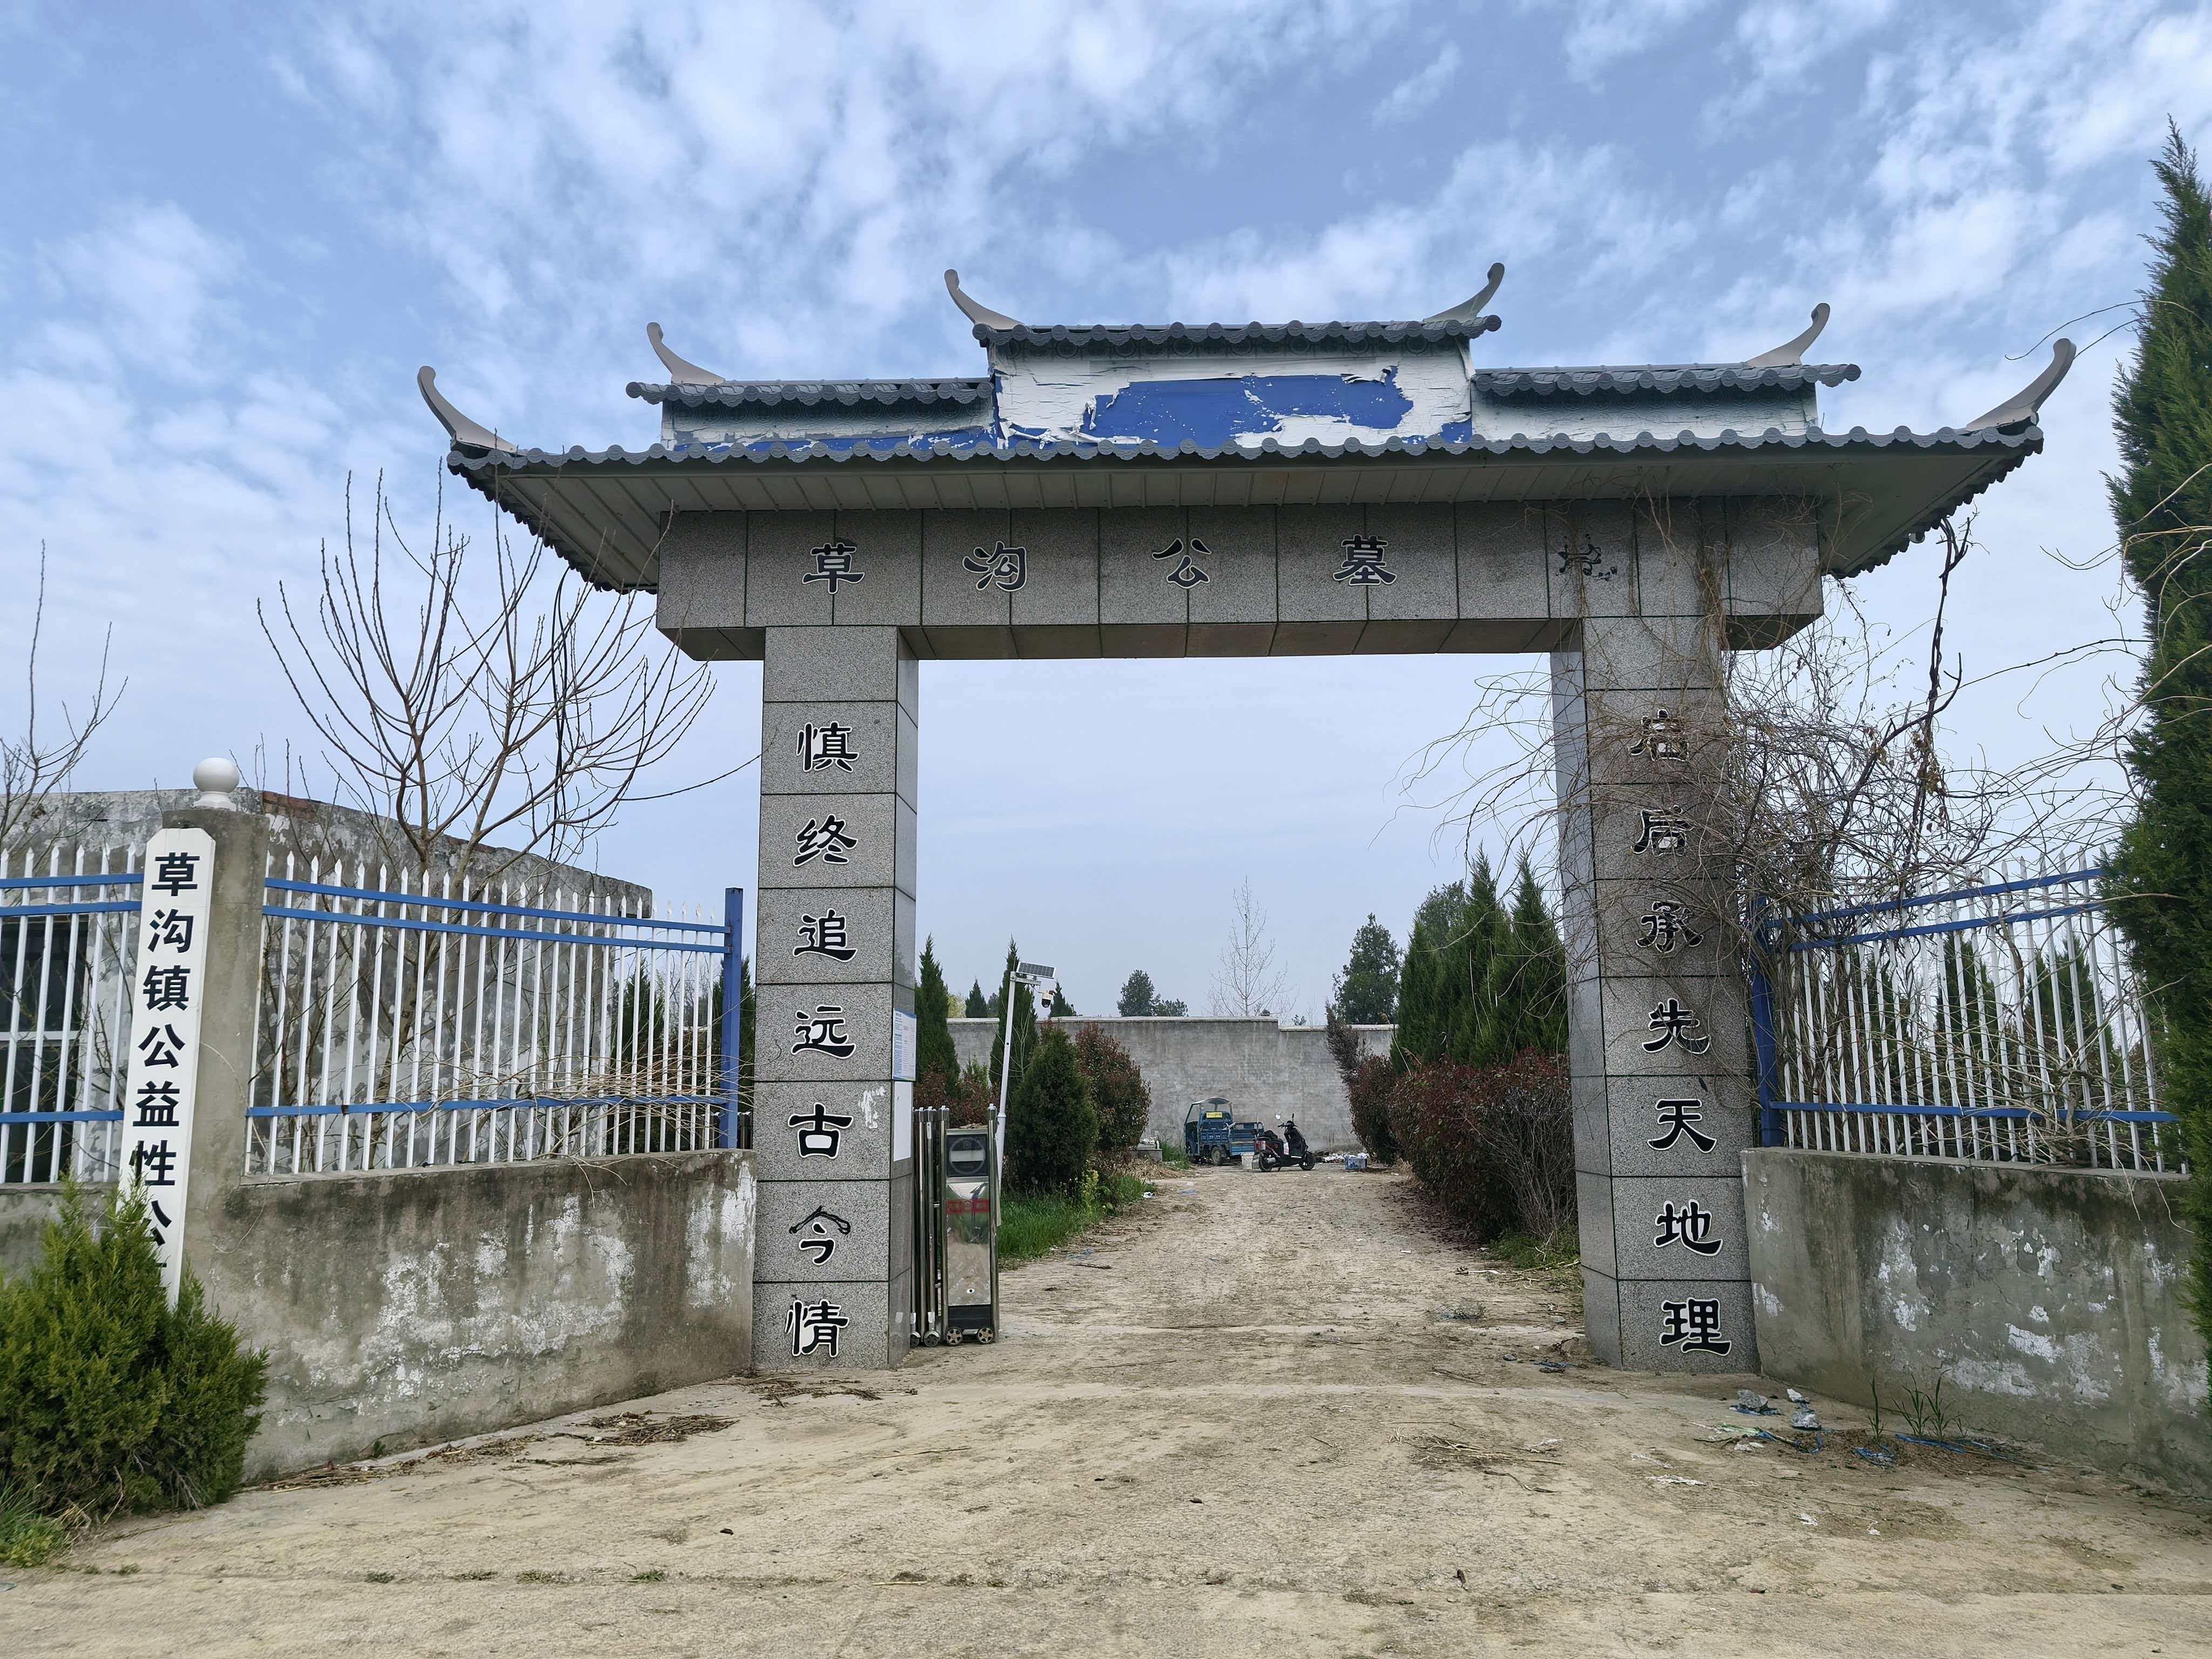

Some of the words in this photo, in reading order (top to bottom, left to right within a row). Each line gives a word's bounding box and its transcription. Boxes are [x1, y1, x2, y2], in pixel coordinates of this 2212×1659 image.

[129, 852, 200, 1267] 草沟镇公益性公
[785, 721, 859, 1357] 慎终追远古今情
